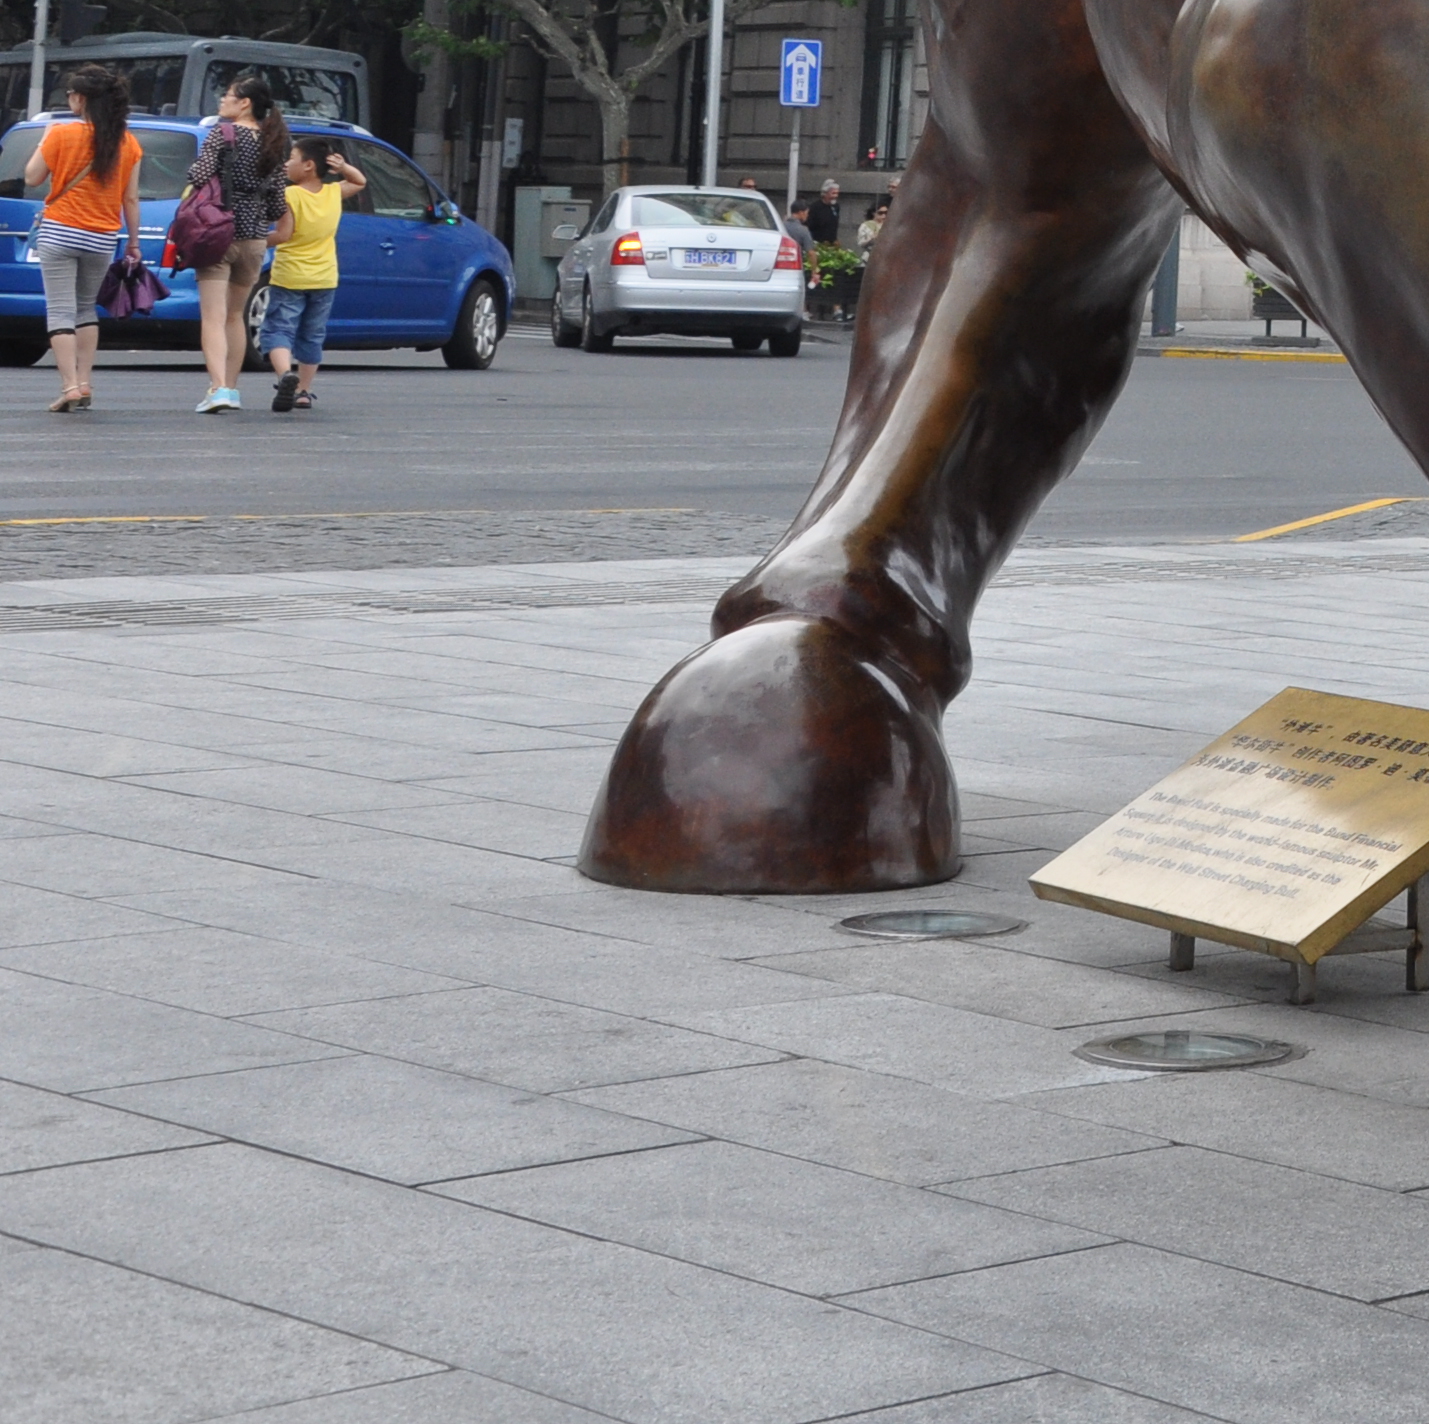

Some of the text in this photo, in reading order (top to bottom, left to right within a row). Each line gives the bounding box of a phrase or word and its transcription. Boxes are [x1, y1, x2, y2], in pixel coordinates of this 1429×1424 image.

[1149, 792, 1167, 802] The
[1219, 807, 1261, 823] specially
[1260, 815, 1291, 827] made
[1289, 819, 1308, 830] for
[1305, 823, 1325, 835] the
[1323, 827, 1357, 841] Bund
[1351, 833, 1403, 853] Financial
[1214, 825, 1230, 838] by
[1229, 829, 1247, 840] the
[1316, 850, 1362, 865] sculptor
[1359, 858, 1379, 871] Mr.
[1158, 858, 1177, 869] the
[1176, 861, 1202, 875] Wall
[1198, 867, 1232, 883] Street
[1228, 874, 1276, 895] Charging
[1244, 855, 1267, 867] also
[1266, 862, 1312, 877] credited
[1306, 871, 1322, 881] as
[1321, 873, 1342, 885] the
